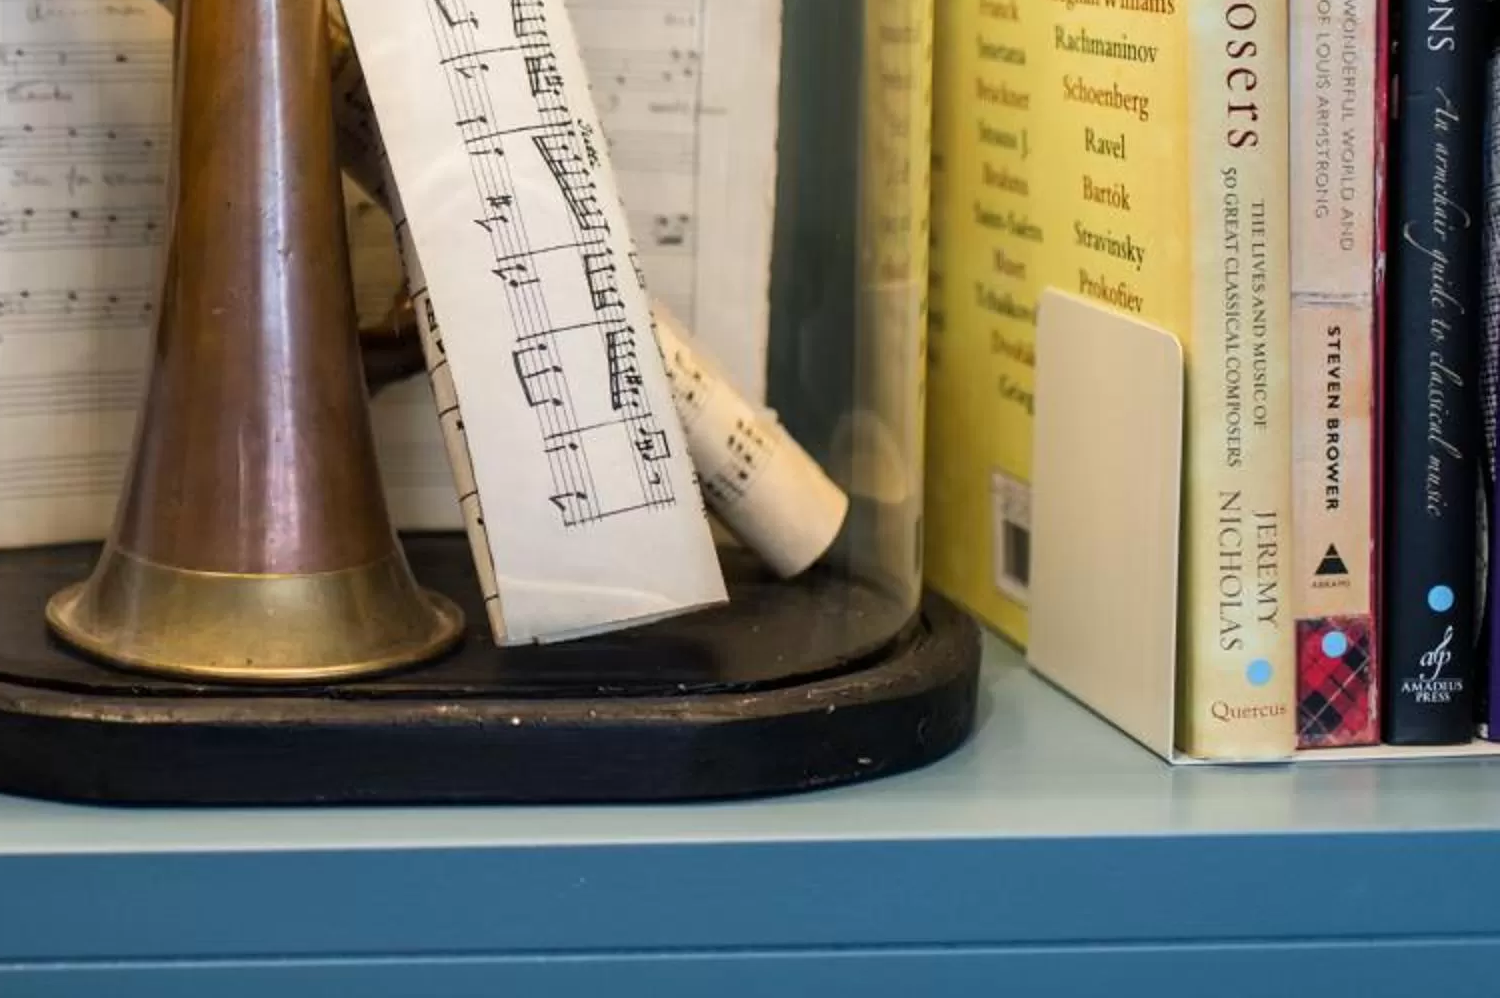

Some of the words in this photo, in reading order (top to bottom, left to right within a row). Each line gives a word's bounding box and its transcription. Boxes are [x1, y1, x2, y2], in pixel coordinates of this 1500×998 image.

[1053, 24, 1159, 64] Rachmaninov
[1315, 29, 1331, 90] LOUIS
[1061, 73, 1150, 122] Schoenberg
[1084, 126, 1127, 160] Ravel
[1314, 94, 1331, 220] ARMSTRONG
[1338, 126, 1356, 203] WORLD
[1251, 197, 1266, 238] THE
[1432, 140, 1472, 243] armchair
[1073, 219, 1145, 272] Stravinsky
[1222, 192, 1240, 254] GREAT
[1338, 207, 1356, 252] AND
[1079, 267, 1144, 313] Prokofiev
[1251, 242, 1267, 294] LIVES
[1403, 219, 1466, 316] guide
[1223, 256, 1242, 354] CLASSICAL
[1252, 295, 1267, 339] AND
[1428, 316, 1453, 346] to
[1252, 342, 1268, 403] MUSIC
[1326, 324, 1342, 402] STEVEN
[1224, 356, 1243, 468] COMPOSERS
[1252, 404, 1268, 435] OF
[1428, 350, 1464, 459] classical
[1325, 417, 1341, 511] BROWER
[1426, 454, 1448, 518] music
[1217, 489, 1244, 652] NICHOLAS
[1251, 509, 1279, 634] JEREMY
[1211, 700, 1288, 722] Quercus
[1401, 681, 1464, 693] AMADEUS
[1415, 691, 1451, 703] PRESS
